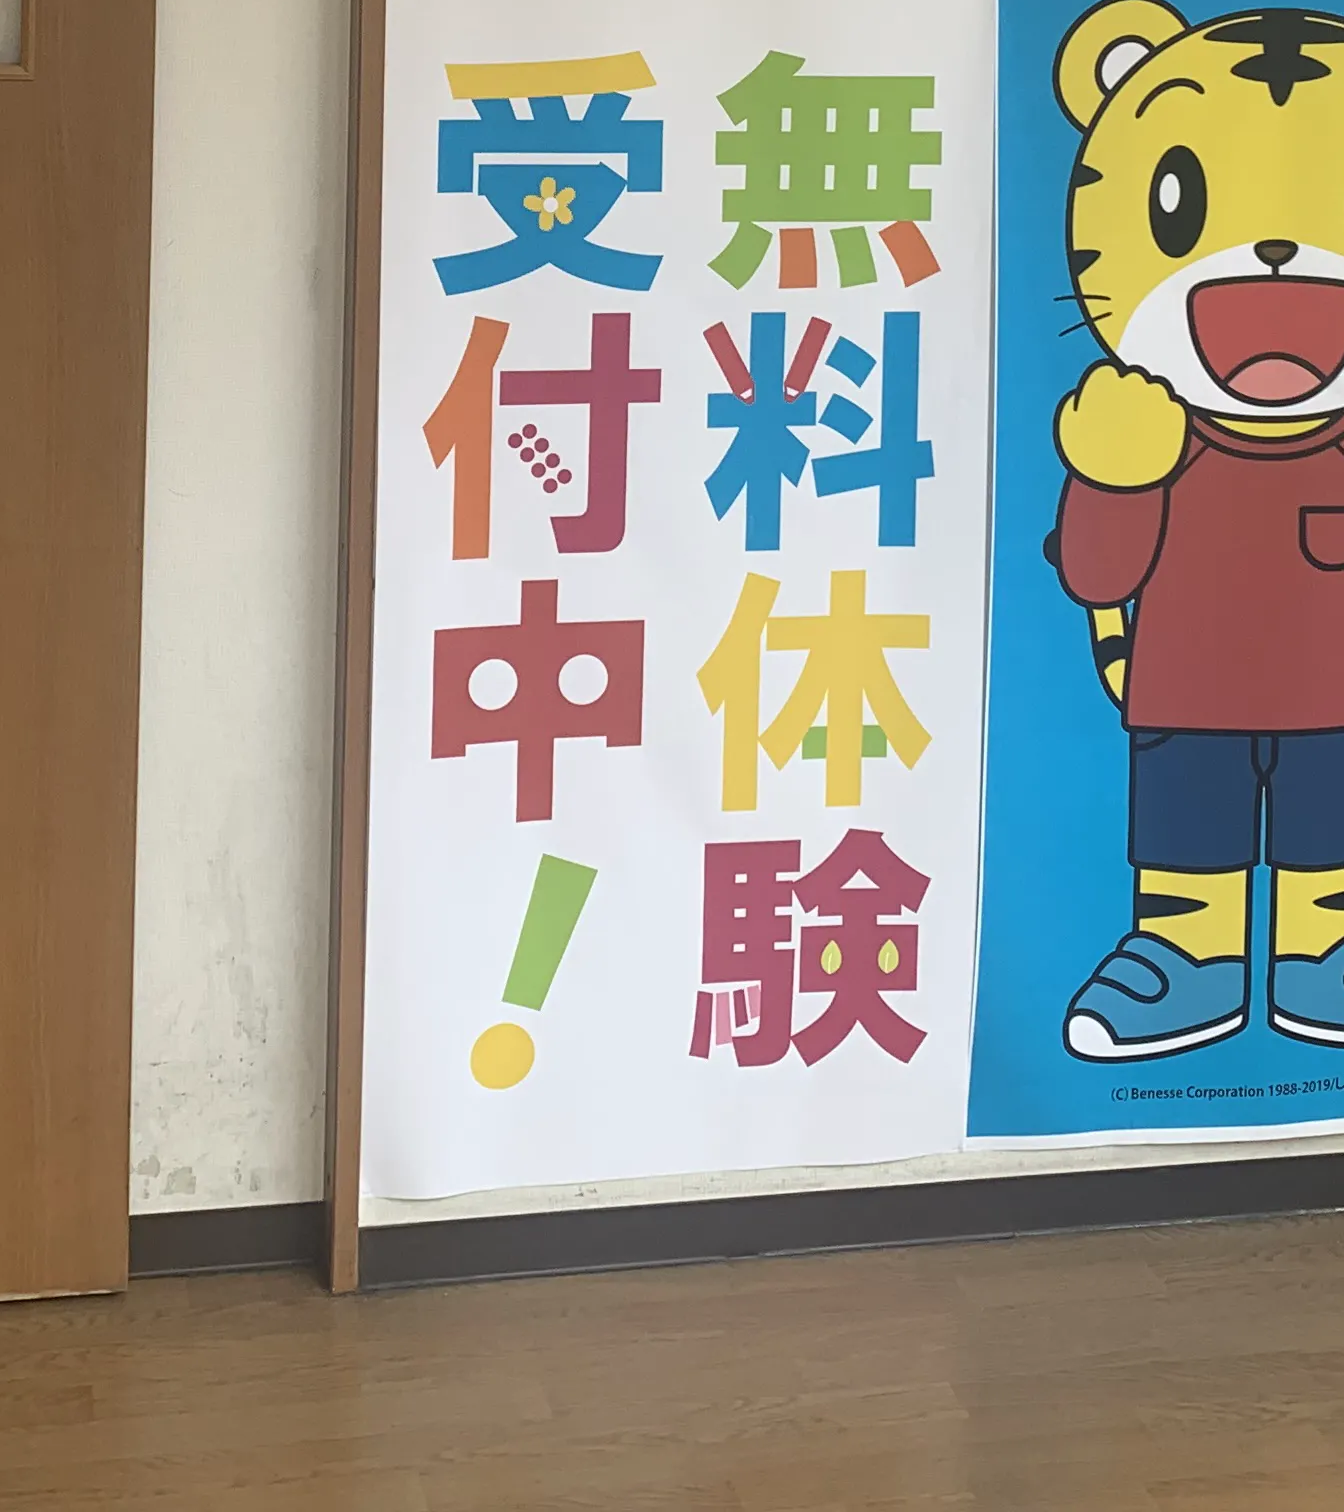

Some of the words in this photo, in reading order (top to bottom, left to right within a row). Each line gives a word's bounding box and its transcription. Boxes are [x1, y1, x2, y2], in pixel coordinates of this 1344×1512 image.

[688, 49, 943, 1068] 無料体験
[1131, 1087, 1183, 1100] Benesse
[1186, 1086, 1264, 1101] Corporation
